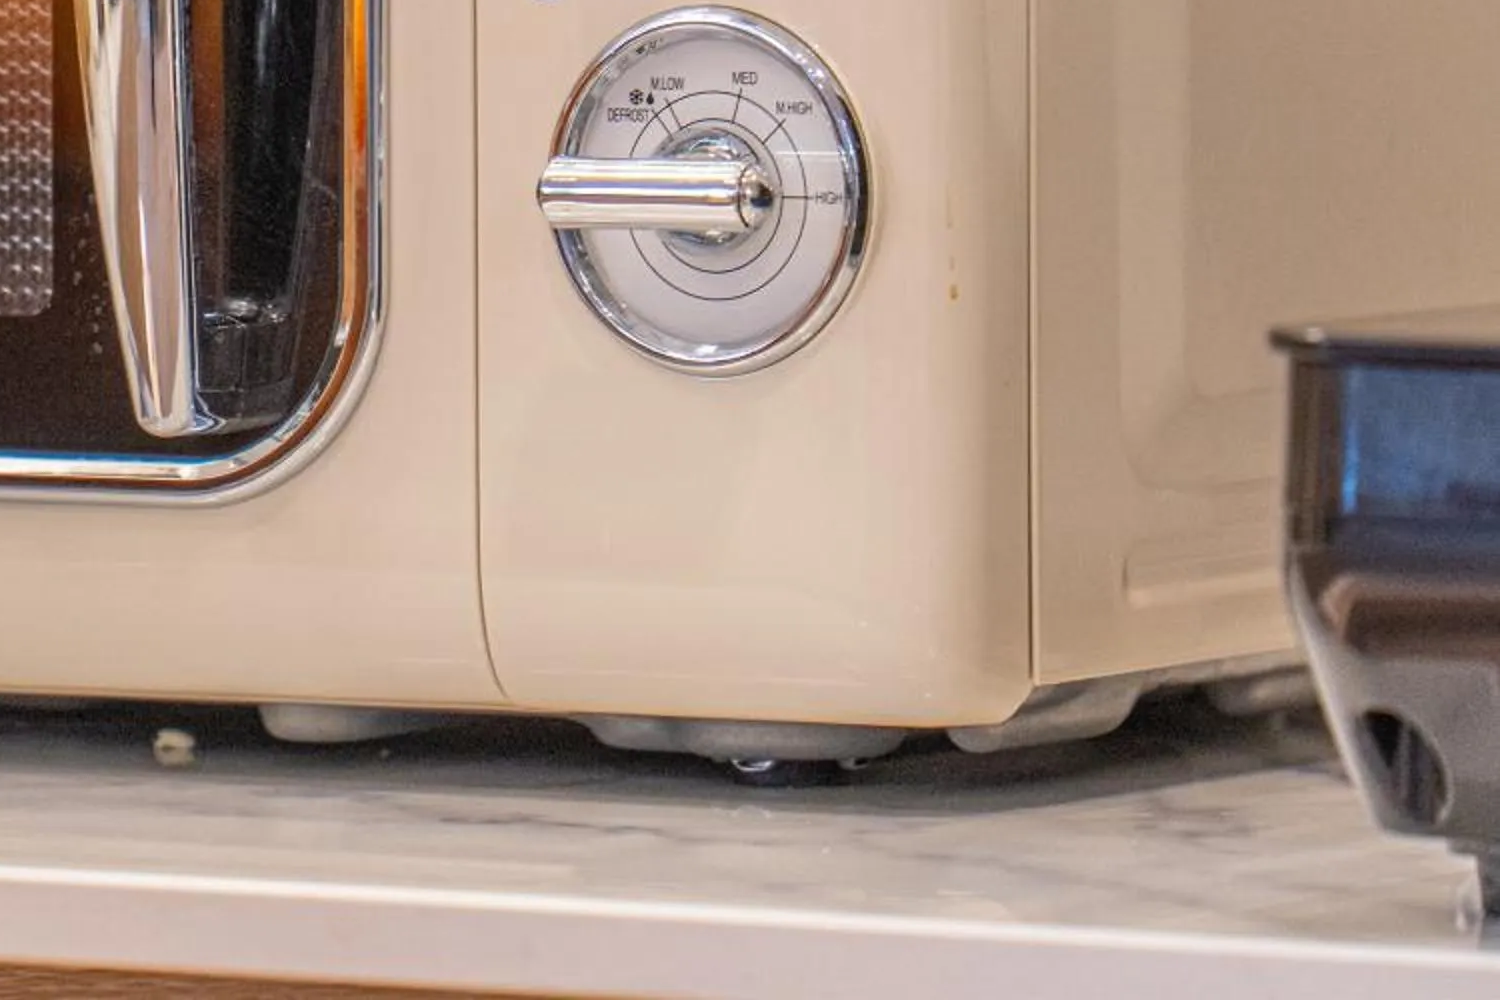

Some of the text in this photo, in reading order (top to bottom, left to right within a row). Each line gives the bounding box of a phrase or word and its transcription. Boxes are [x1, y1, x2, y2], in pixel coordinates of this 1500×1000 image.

[732, 71, 758, 85] MED
[607, 107, 649, 122] DEFROST
[775, 101, 813, 115] M.HIGH
[814, 191, 843, 205] HIGH
